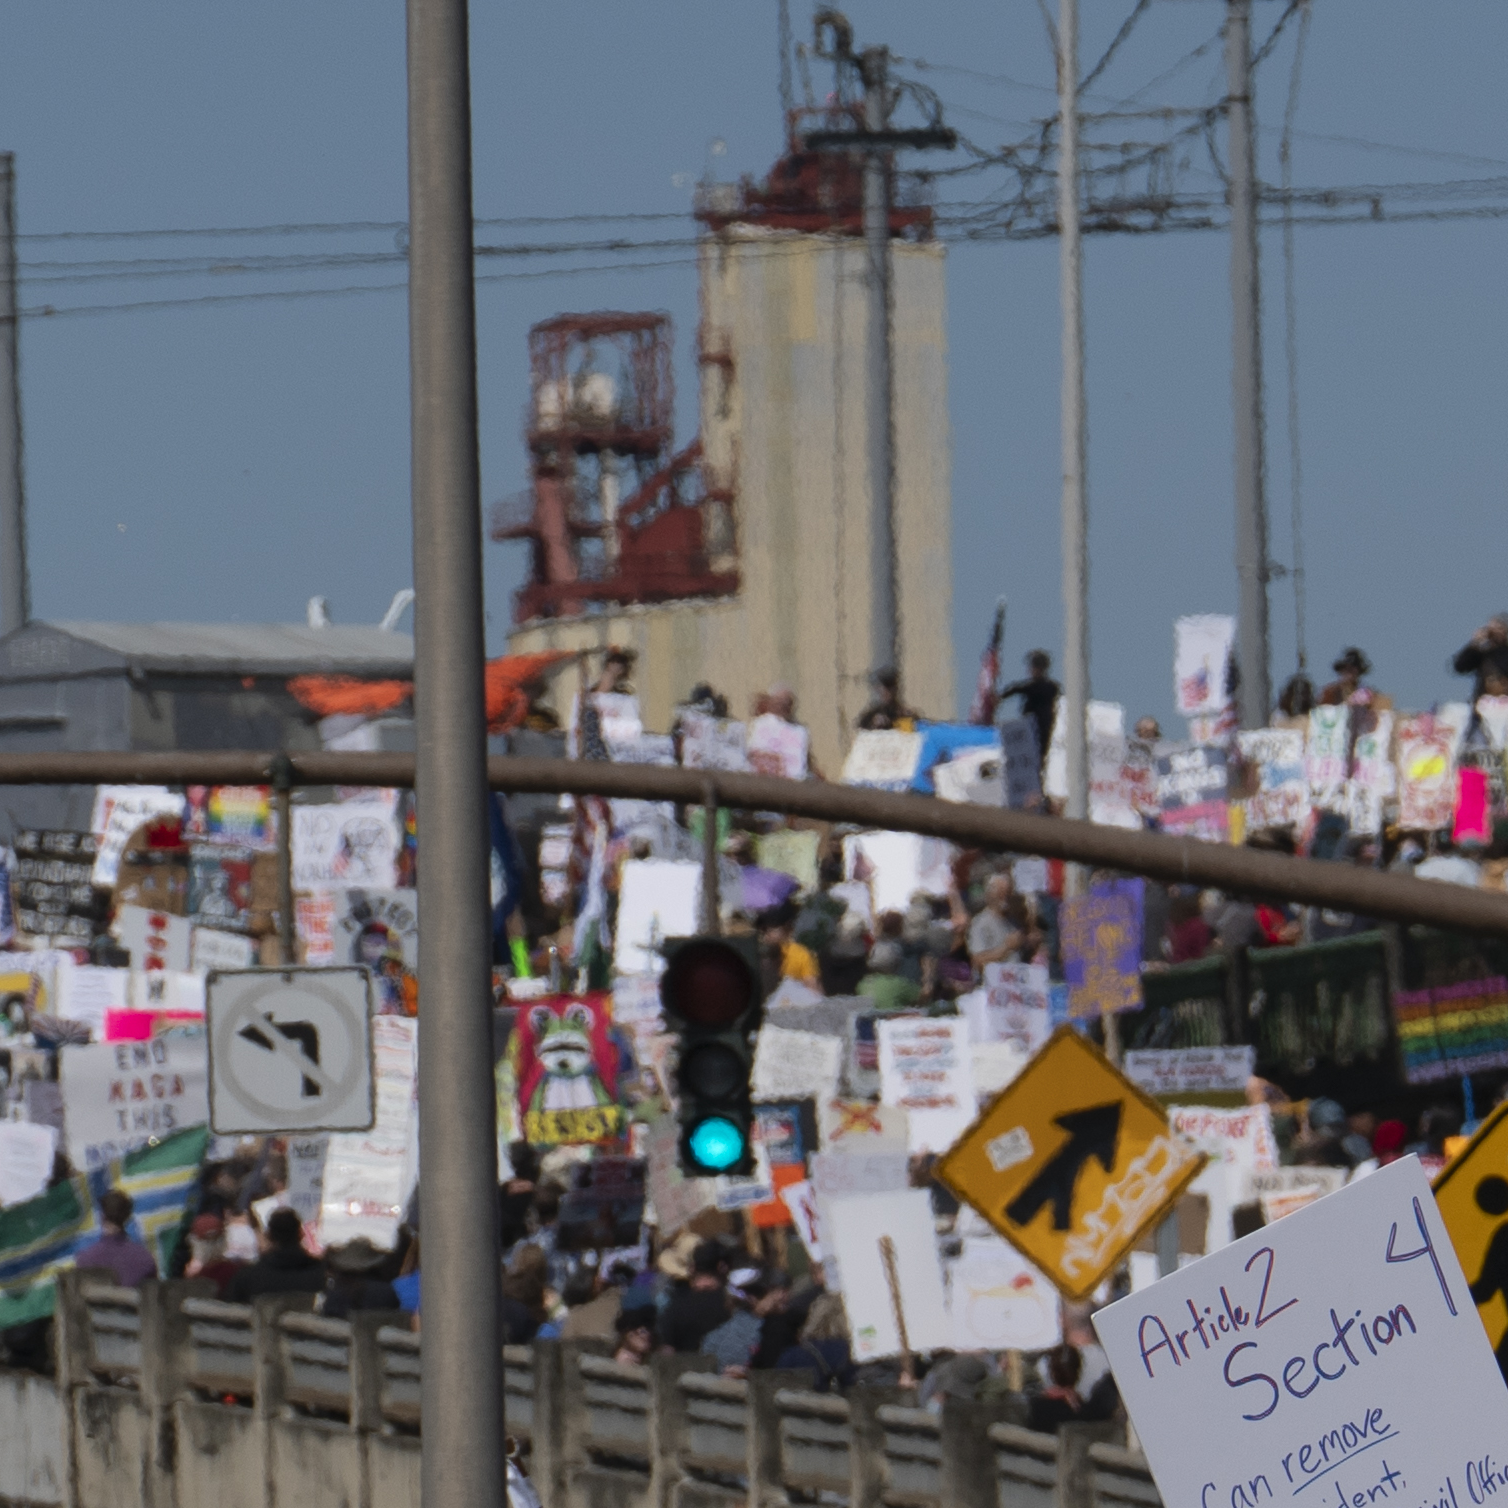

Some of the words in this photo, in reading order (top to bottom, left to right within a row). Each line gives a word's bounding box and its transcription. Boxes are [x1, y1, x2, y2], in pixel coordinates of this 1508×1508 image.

[1137, 1287, 1250, 1377] Article
[1242, 1247, 1299, 1330] 2
[1222, 1303, 1417, 1421] Section
[1386, 1196, 1458, 1316] 4
[1287, 1407, 1392, 1482] remove
